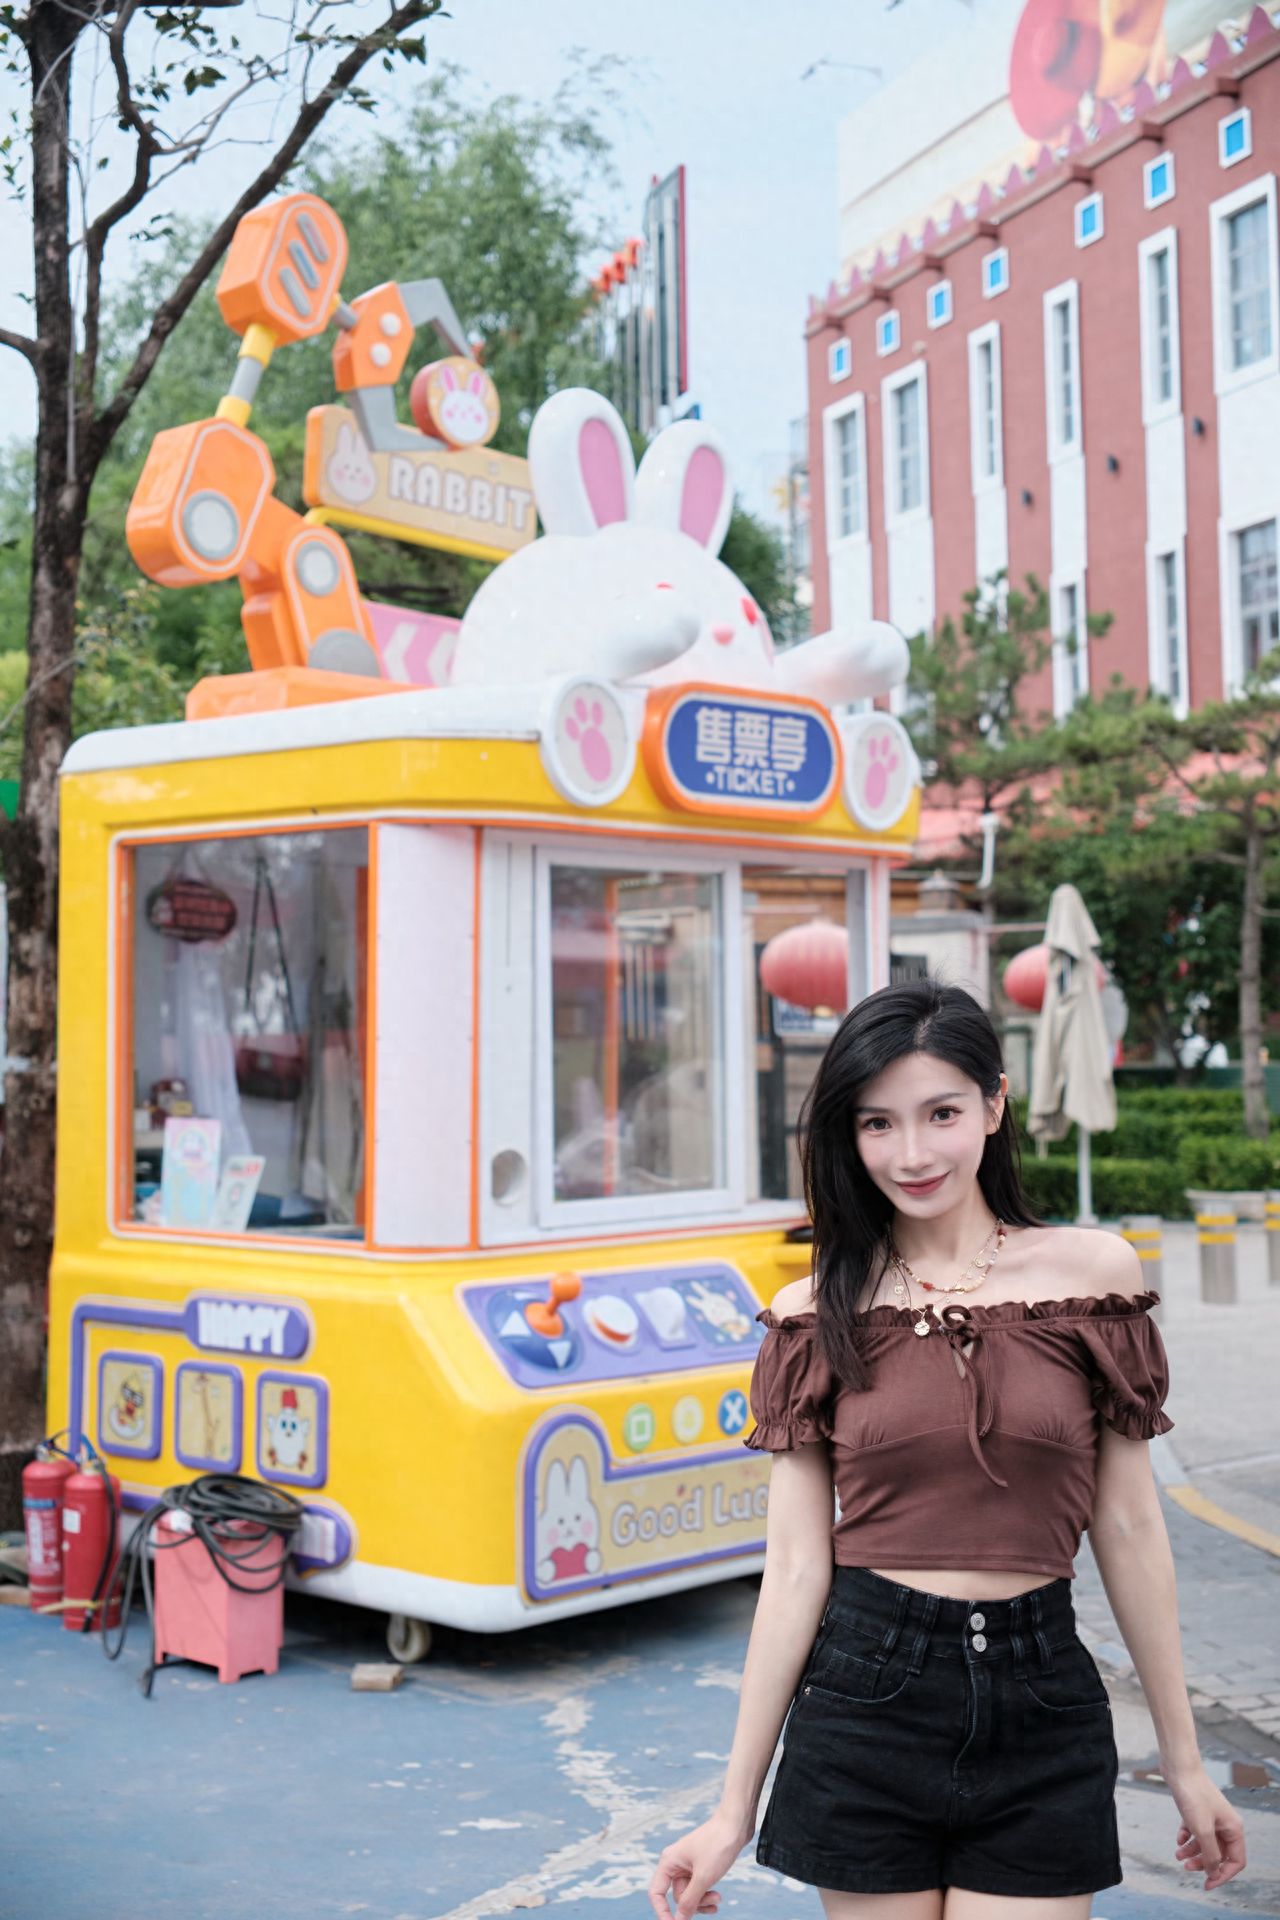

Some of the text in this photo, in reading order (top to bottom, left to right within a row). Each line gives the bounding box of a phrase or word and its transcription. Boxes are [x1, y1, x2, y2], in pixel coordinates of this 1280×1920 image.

[389, 453, 533, 532] RABBIT
[695, 706, 807, 772] 售票亭
[713, 765, 788, 796] TICKET
[611, 1482, 769, 1547] Good Luc
